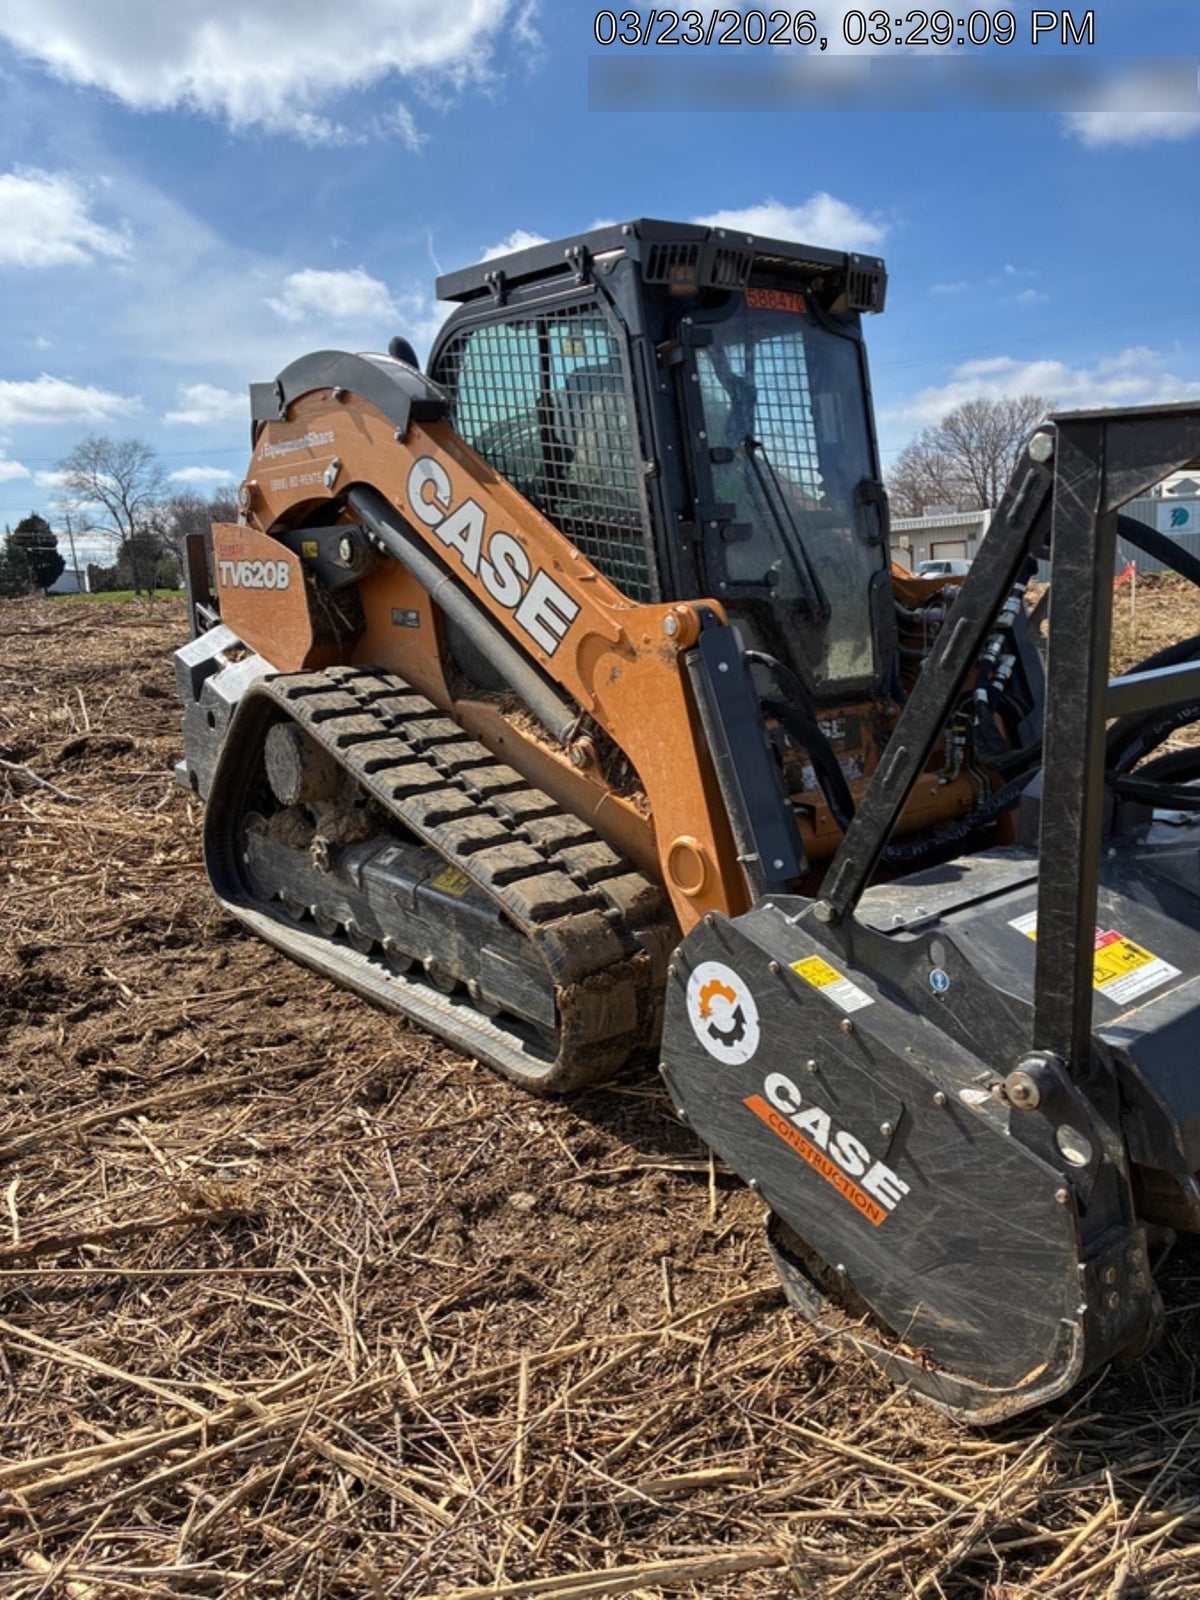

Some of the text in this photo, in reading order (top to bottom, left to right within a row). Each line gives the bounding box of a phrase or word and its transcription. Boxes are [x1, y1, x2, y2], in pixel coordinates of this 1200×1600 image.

[218, 559, 290, 590] TV620B
[407, 455, 582, 658] CASE
[763, 1071, 912, 1211] CASE
[767, 1112, 880, 1221] CONSTRUCTION
